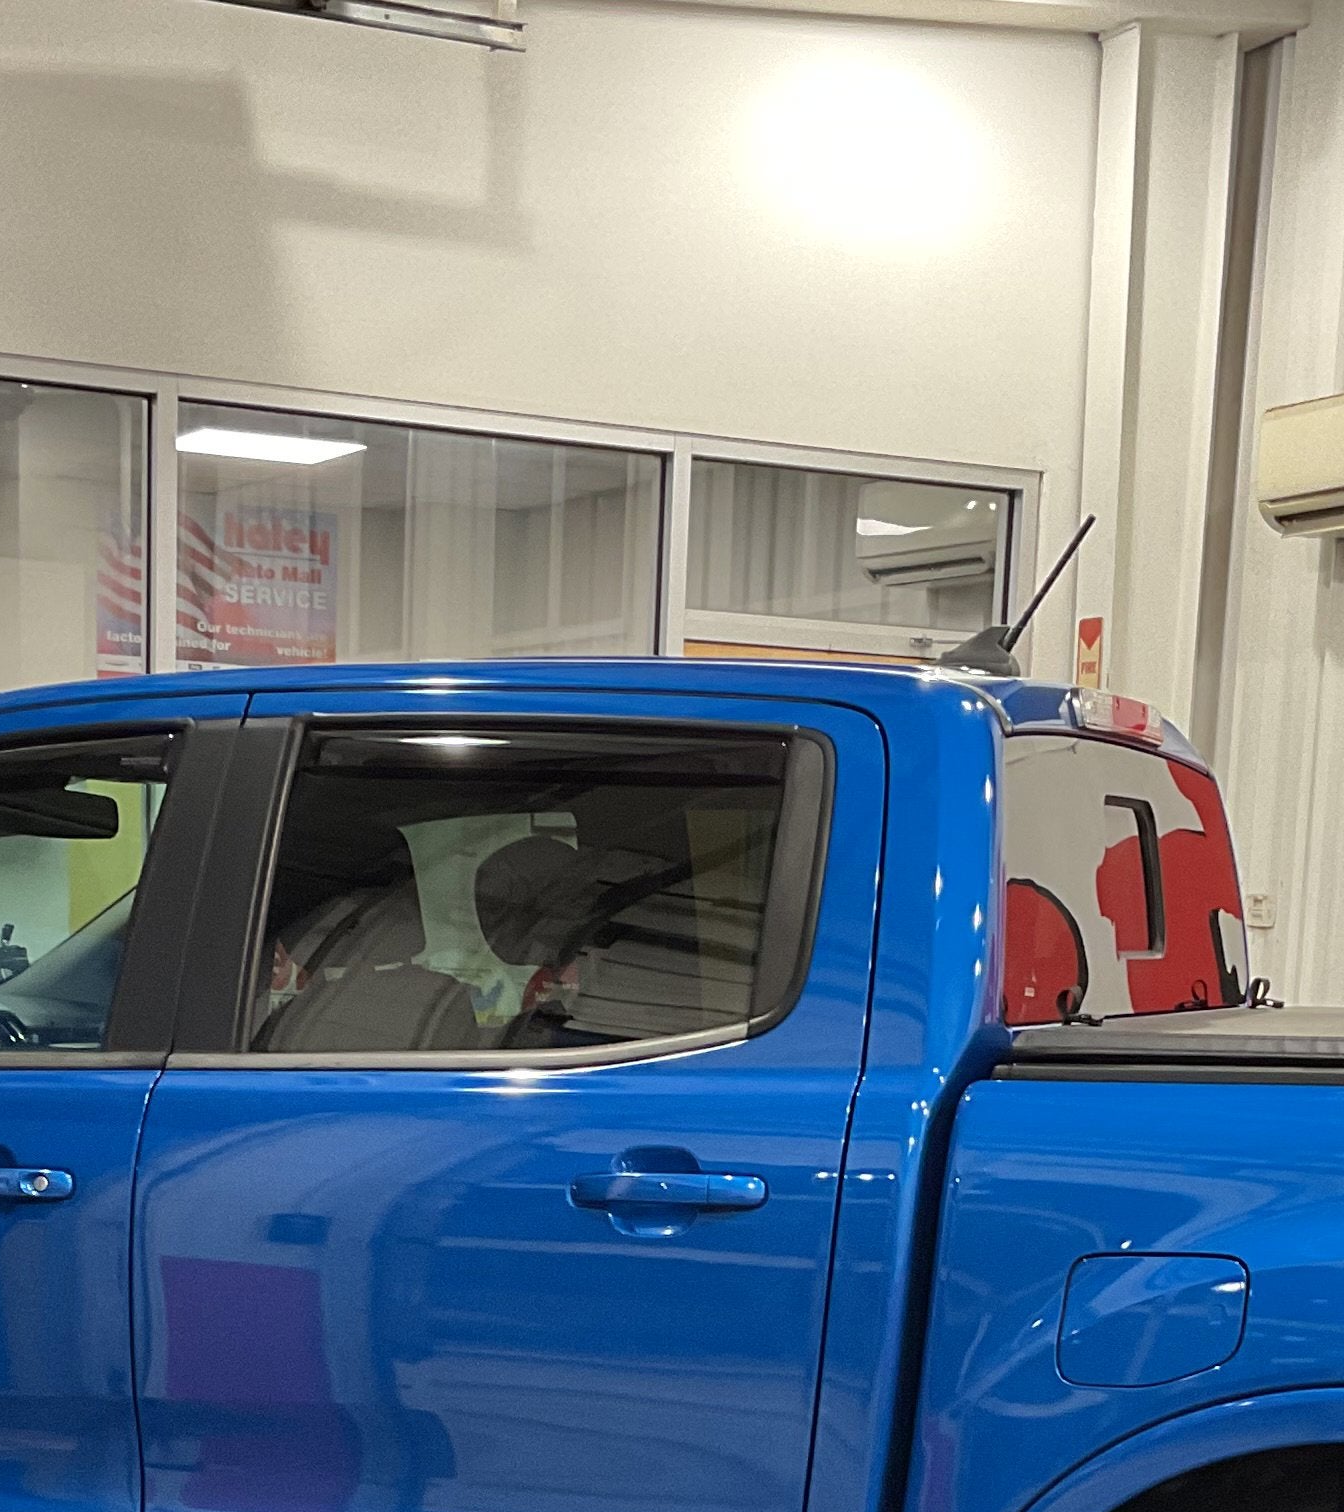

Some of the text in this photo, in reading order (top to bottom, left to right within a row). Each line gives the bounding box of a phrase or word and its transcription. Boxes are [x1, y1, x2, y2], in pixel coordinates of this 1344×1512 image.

[223, 511, 330, 567] haley
[281, 566, 322, 585] Mall
[225, 583, 328, 610] SERVICE
[197, 620, 222, 634] Our
[106, 630, 232, 652] facto ined for
